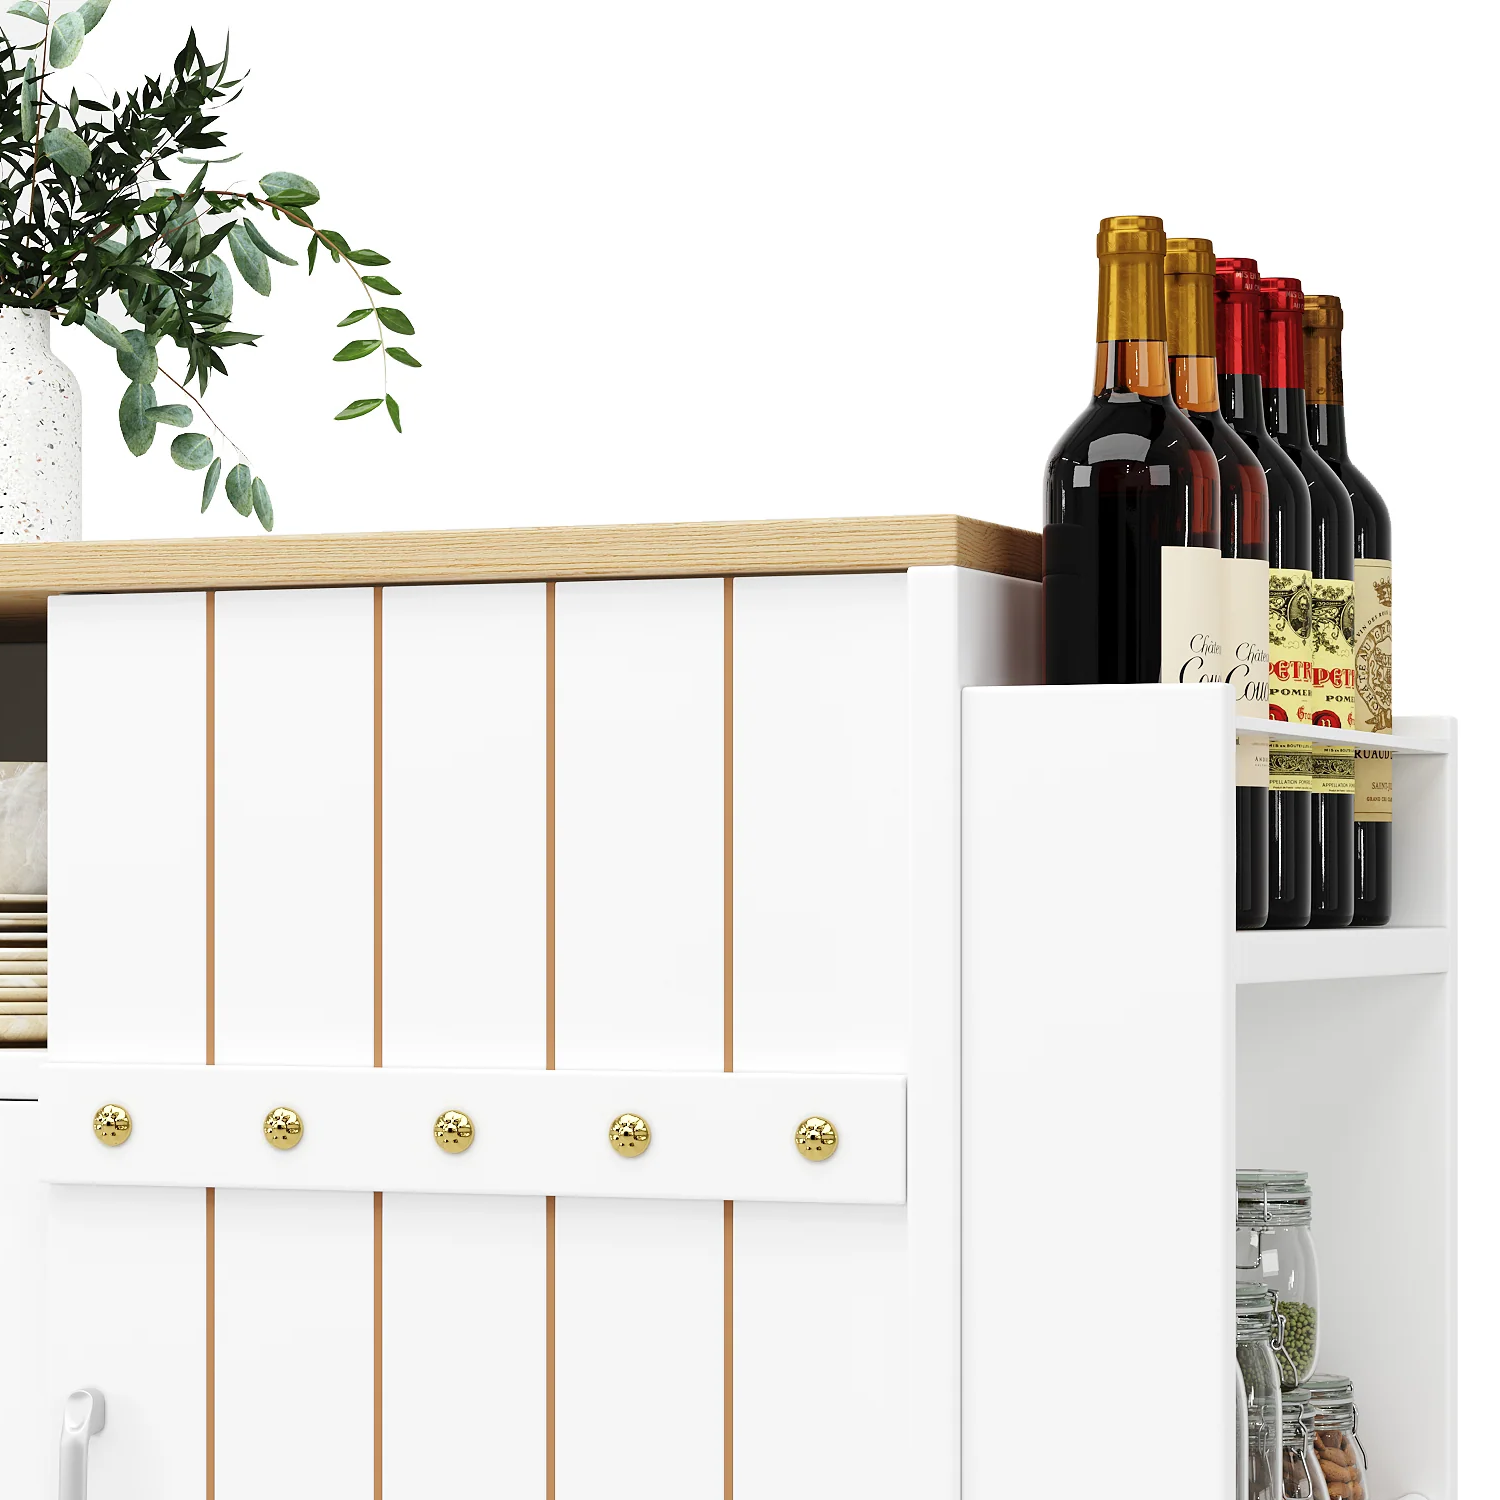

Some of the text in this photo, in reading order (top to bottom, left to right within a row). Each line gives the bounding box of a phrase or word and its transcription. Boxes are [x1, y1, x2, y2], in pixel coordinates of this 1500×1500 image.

[1356, 625, 1368, 638] VIN
[1367, 615, 1378, 626] DES
[1189, 633, 1221, 656] Châte
[1312, 667, 1354, 689] PET
